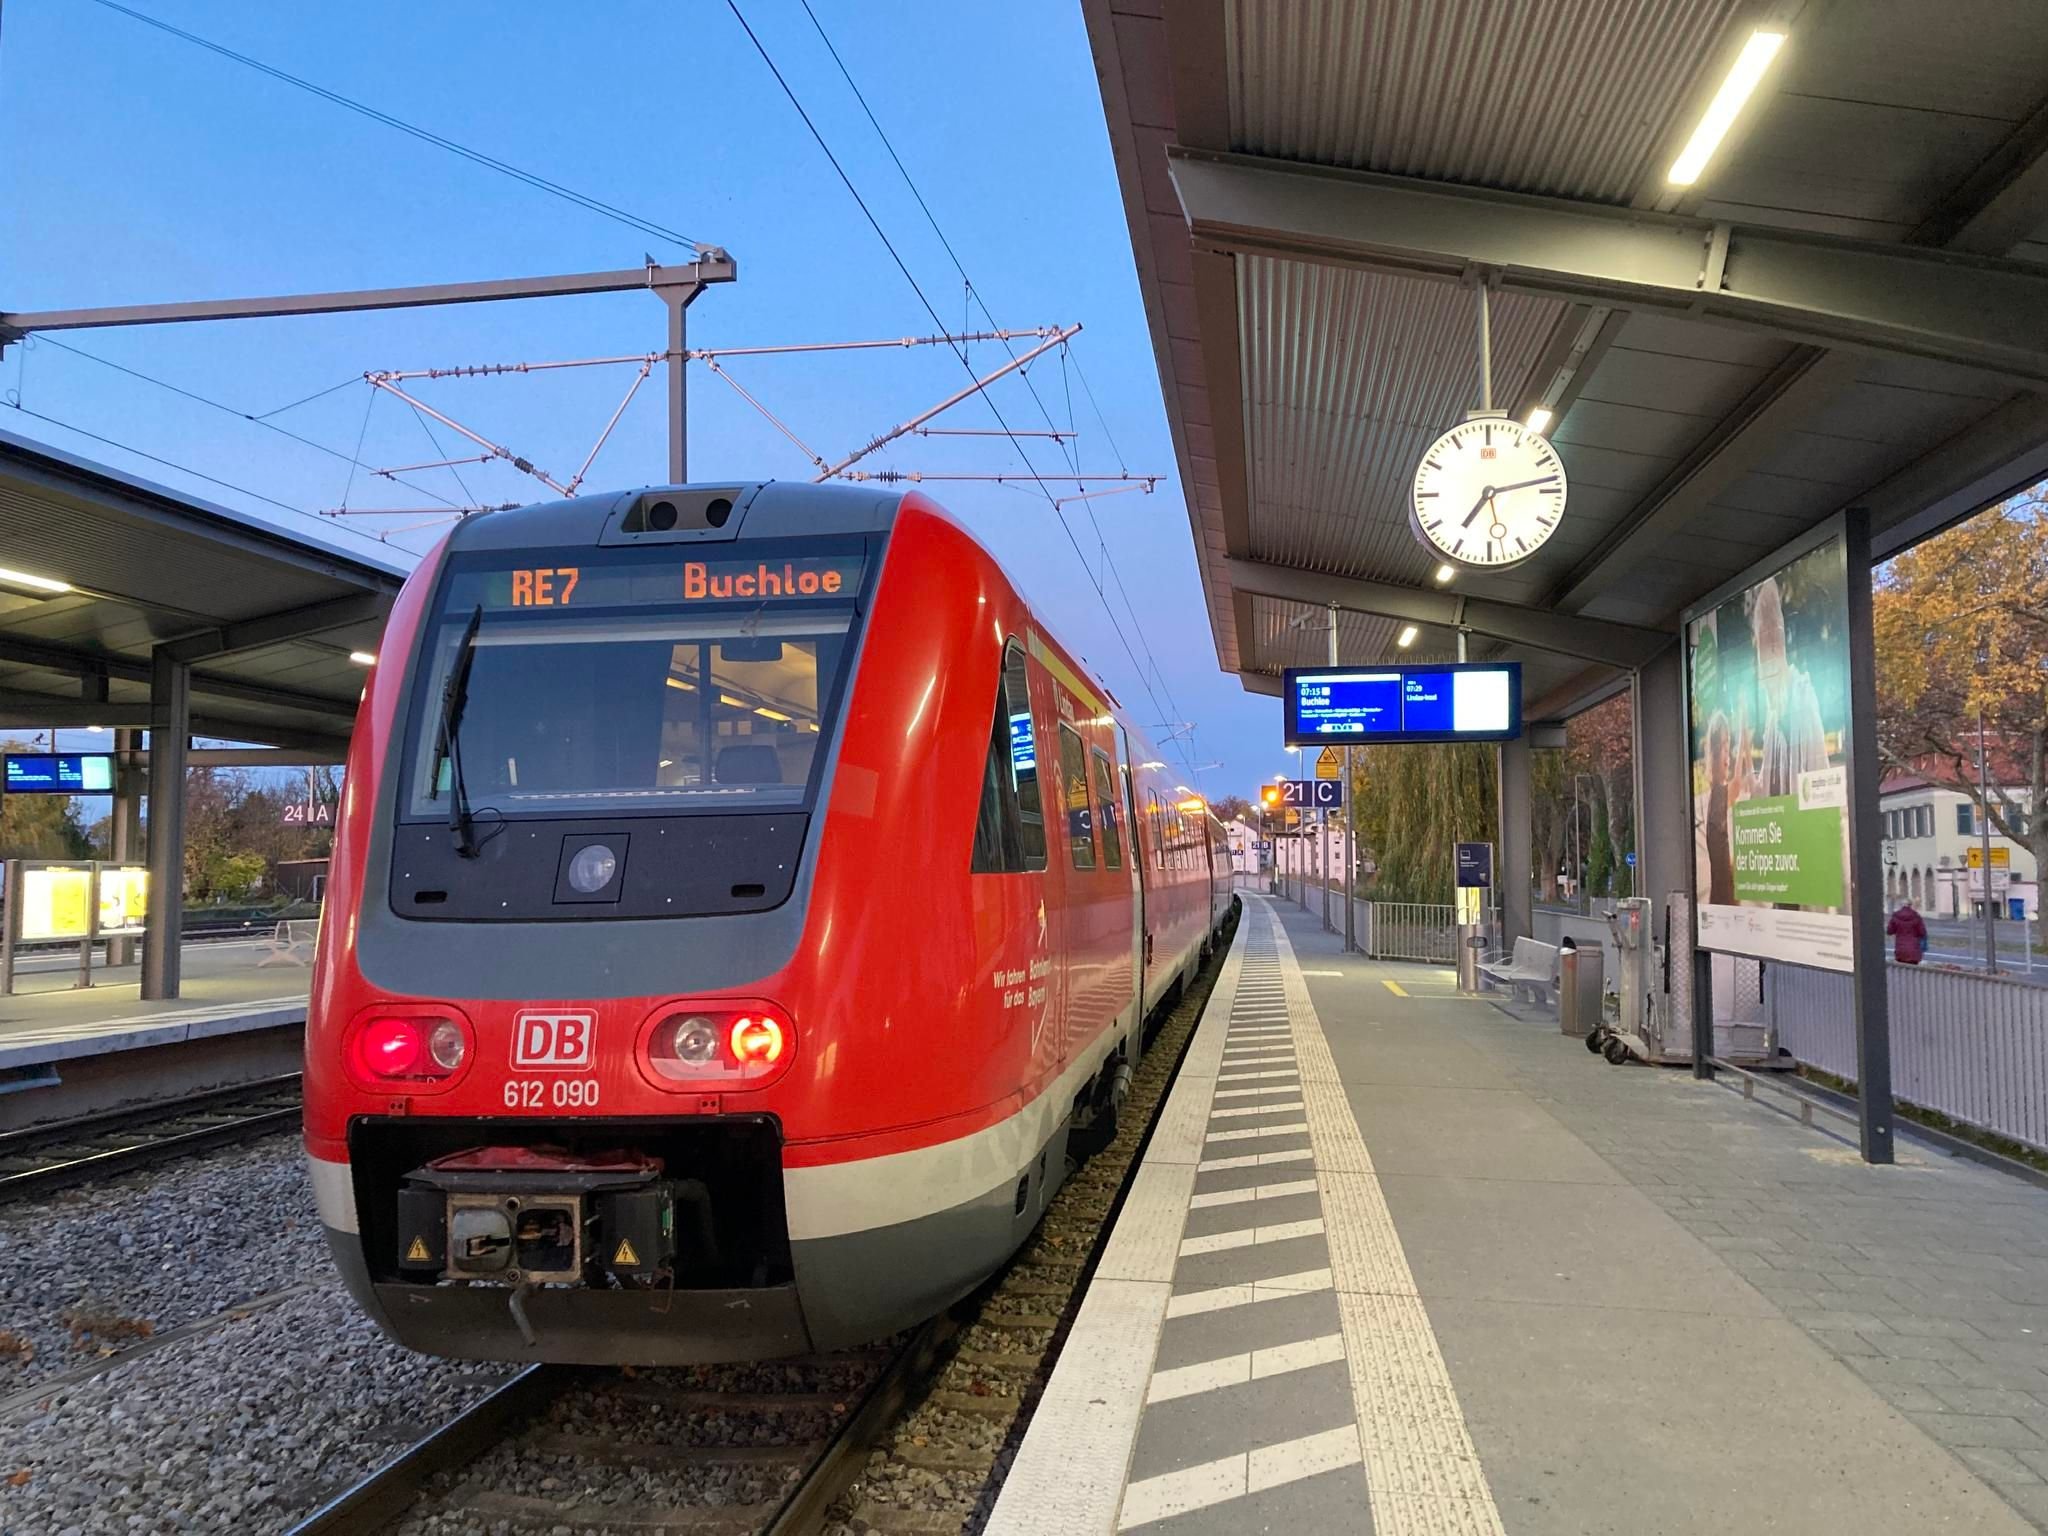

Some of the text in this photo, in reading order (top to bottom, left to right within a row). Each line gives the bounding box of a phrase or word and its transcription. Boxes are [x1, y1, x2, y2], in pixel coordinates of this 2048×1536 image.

[512, 562, 842, 606] RE7 Buchloe
[1301, 688, 1320, 696] 07:15
[1301, 697, 1330, 706] Buchloe
[1283, 782, 1333, 802] 21 C
[284, 805, 329, 821] 24 A
[1736, 821, 1782, 845] Kommen Sie
[1736, 849, 1800, 877] der Grippe zuvor.
[993, 970, 1006, 989] Wir
[1013, 989, 1025, 1006] das
[521, 1019, 585, 1060] DB
[504, 1080, 599, 1107] 612 090
